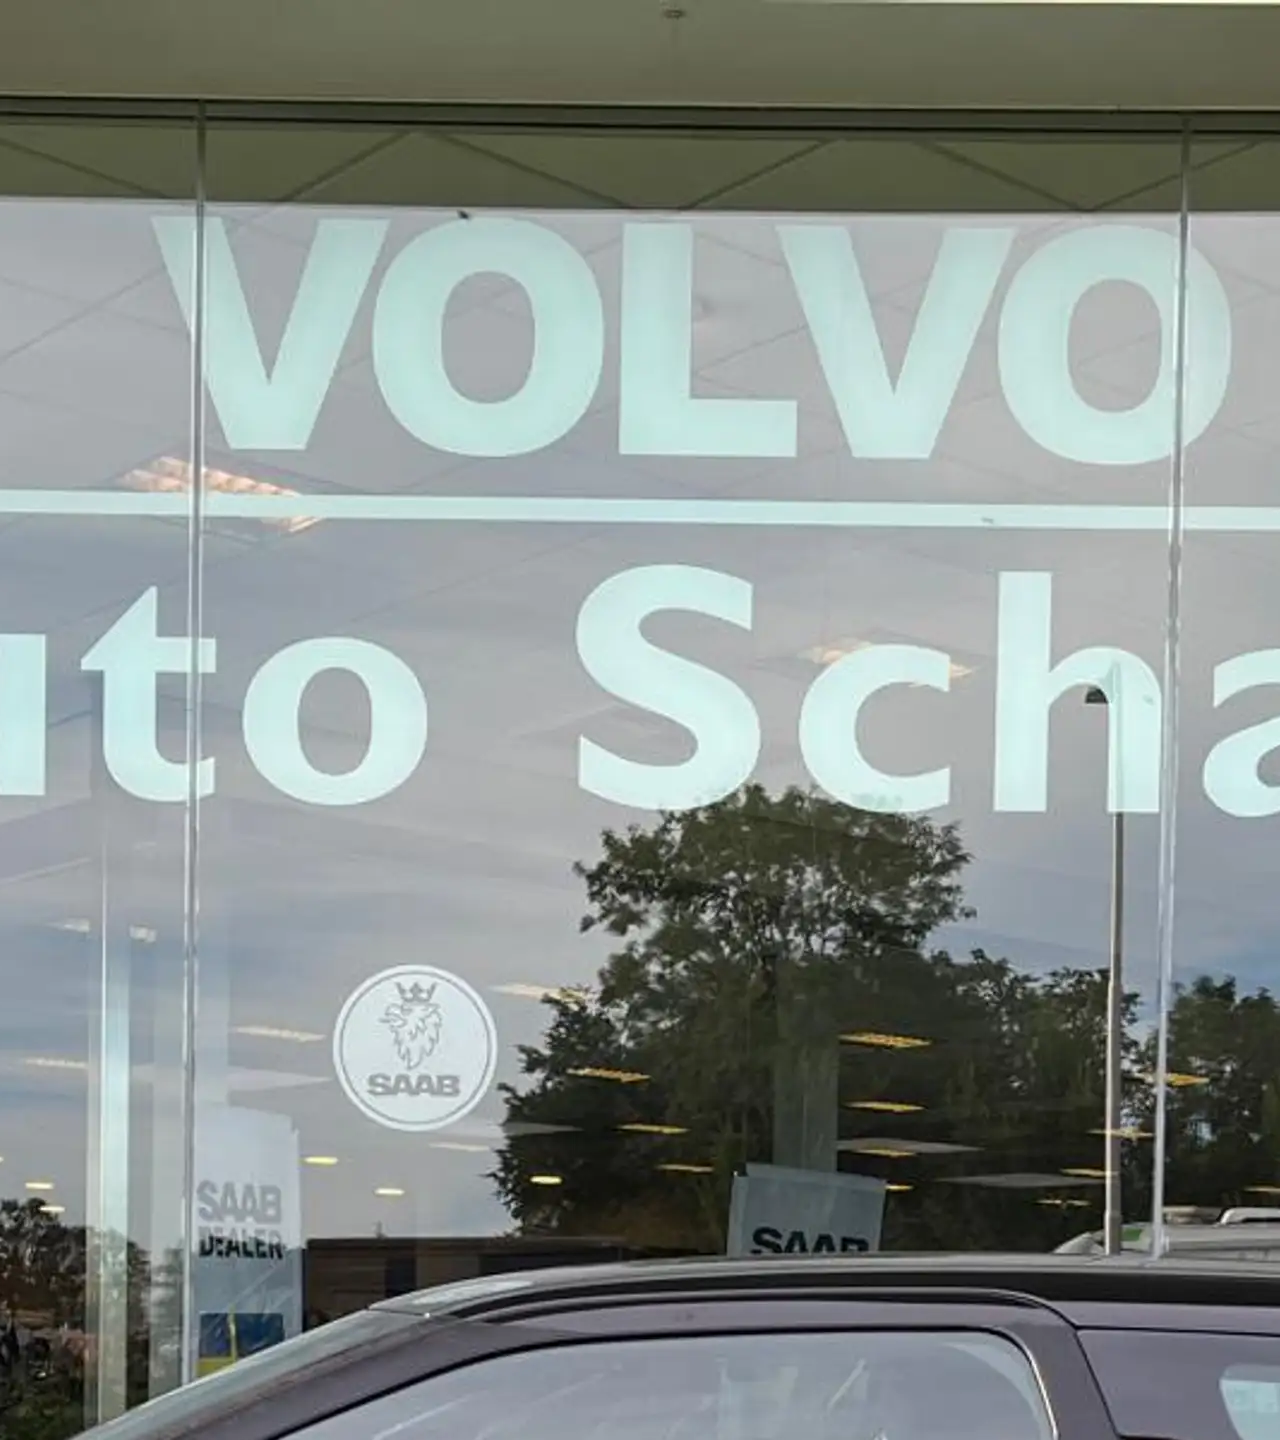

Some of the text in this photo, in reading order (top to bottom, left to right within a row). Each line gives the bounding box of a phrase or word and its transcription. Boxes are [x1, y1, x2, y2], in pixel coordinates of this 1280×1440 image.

[151, 216, 1232, 465] VOLVO
[367, 1073, 461, 1097] SAAB
[197, 1180, 282, 1224] SAAB
[199, 1226, 283, 1260] DEALER
